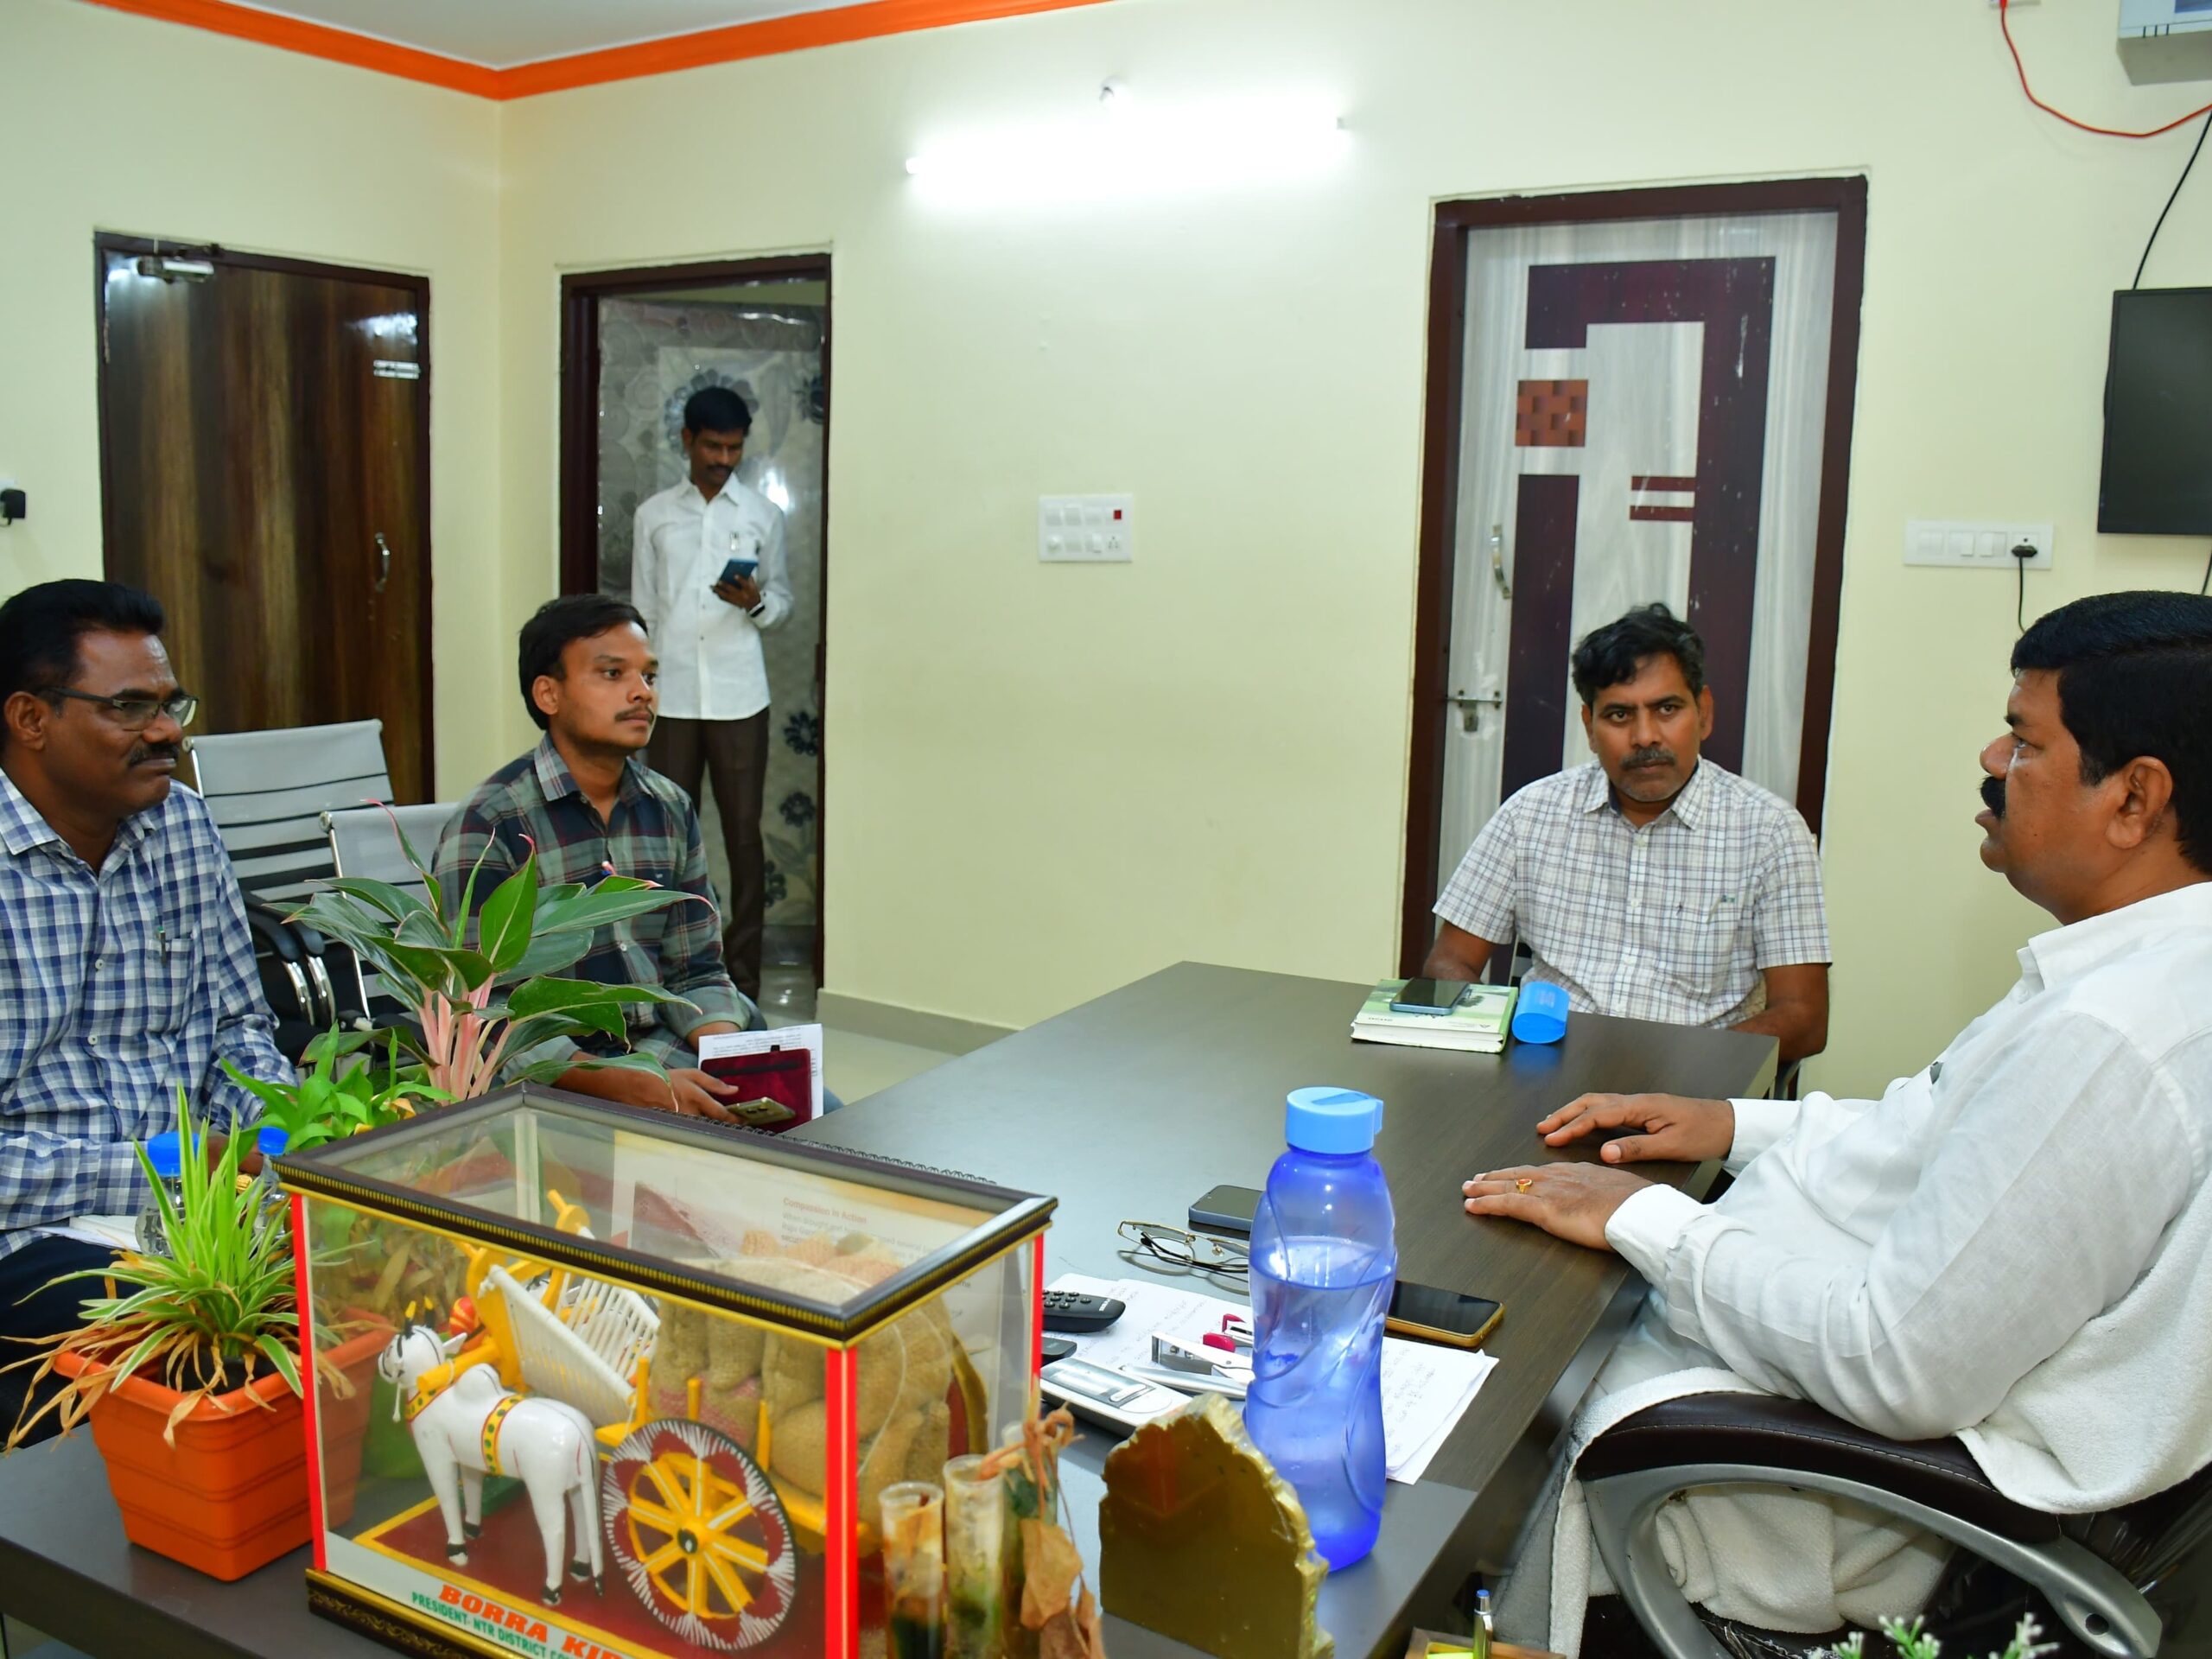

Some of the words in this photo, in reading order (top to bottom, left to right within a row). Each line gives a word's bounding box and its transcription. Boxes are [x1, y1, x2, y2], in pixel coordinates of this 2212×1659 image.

[783, 1197, 830, 1216] Compassion
[832, 1208, 840, 1218] in
[842, 1211, 868, 1224] Action
[439, 1585, 547, 1643] BORRA
[474, 1618, 494, 1637] NTR
[498, 1628, 546, 1658] DISTRICT
